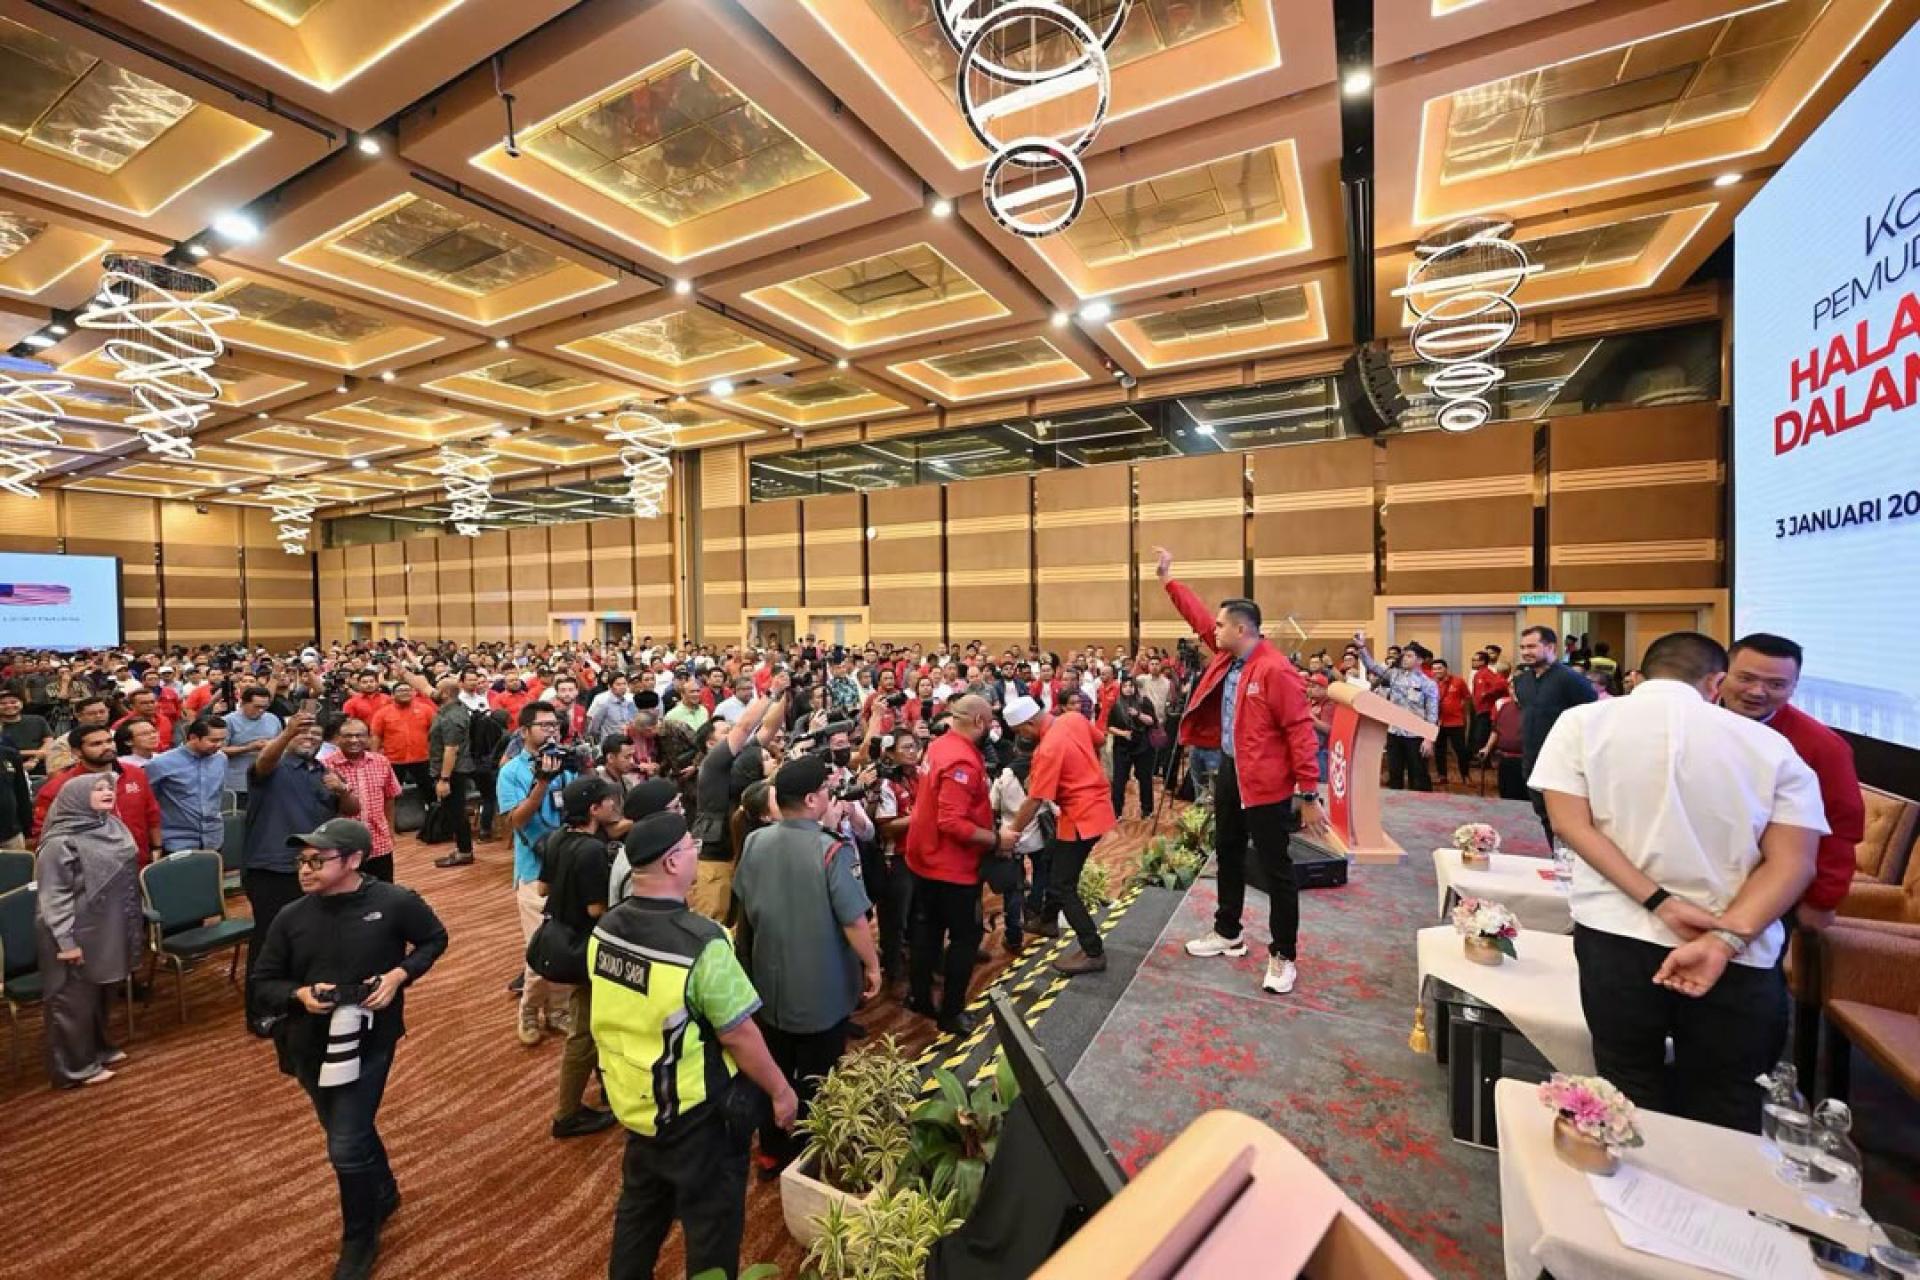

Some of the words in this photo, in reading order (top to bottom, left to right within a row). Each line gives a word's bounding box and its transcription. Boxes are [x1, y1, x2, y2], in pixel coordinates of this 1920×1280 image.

[1790, 292, 1920, 403] HALA
[1775, 518, 1786, 539] 3
[1788, 497, 1882, 536] JANUARI
[1887, 490, 1920, 520] 20
